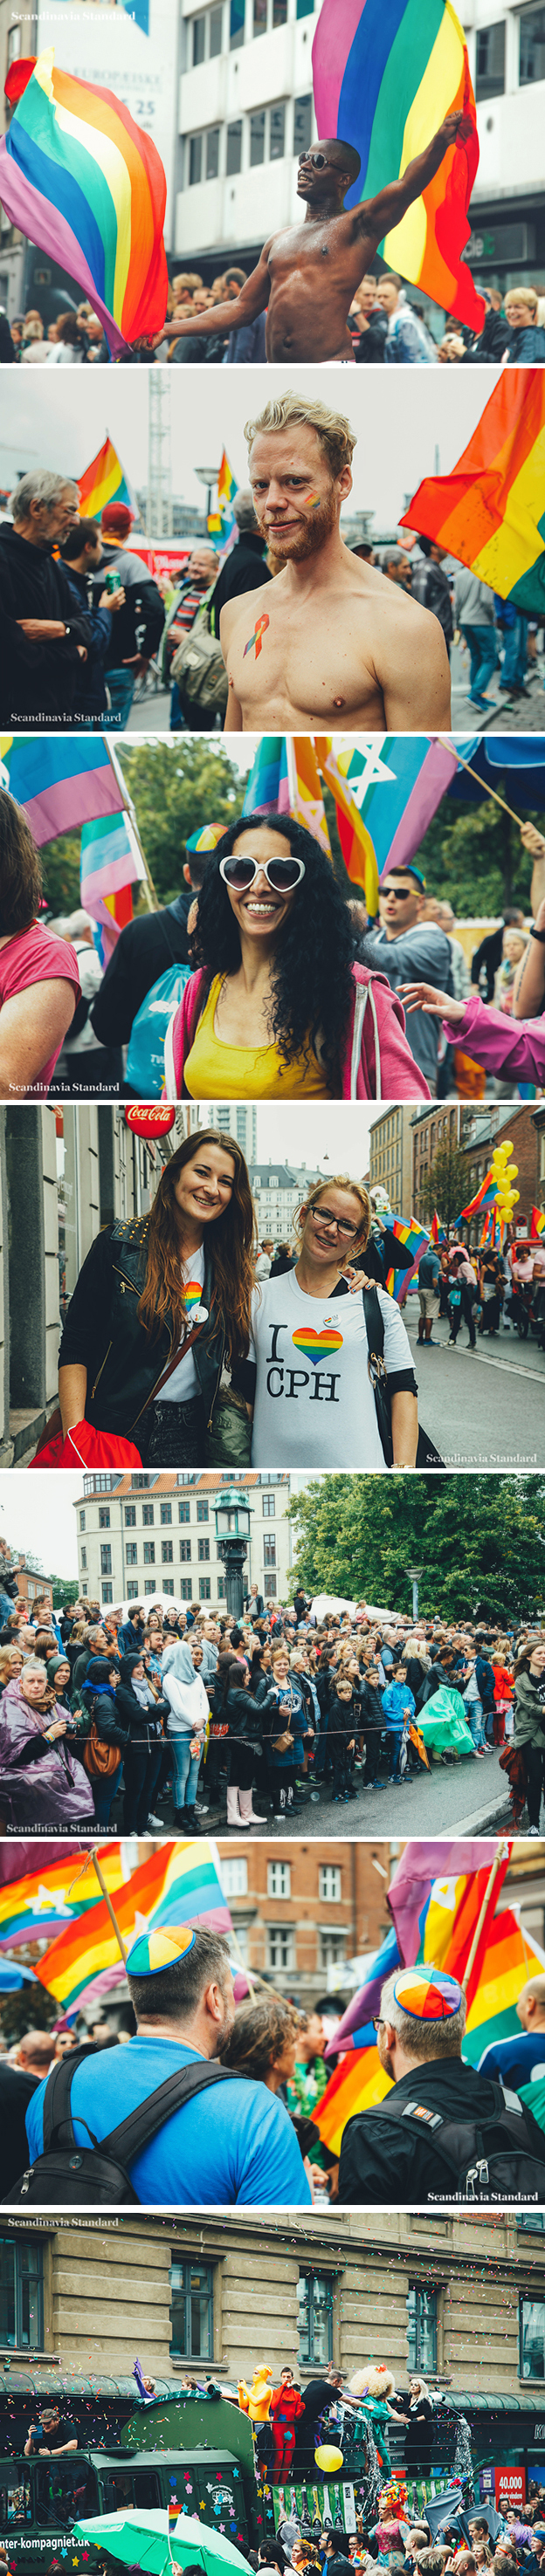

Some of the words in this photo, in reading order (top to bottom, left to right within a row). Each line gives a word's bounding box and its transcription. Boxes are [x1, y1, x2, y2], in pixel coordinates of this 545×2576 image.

[128, 1105, 174, 1122] Coca-Cola
[266, 1323, 288, 1364] I
[266, 1366, 341, 1402] CPH
[499, 2476, 523, 2490] 40.000
